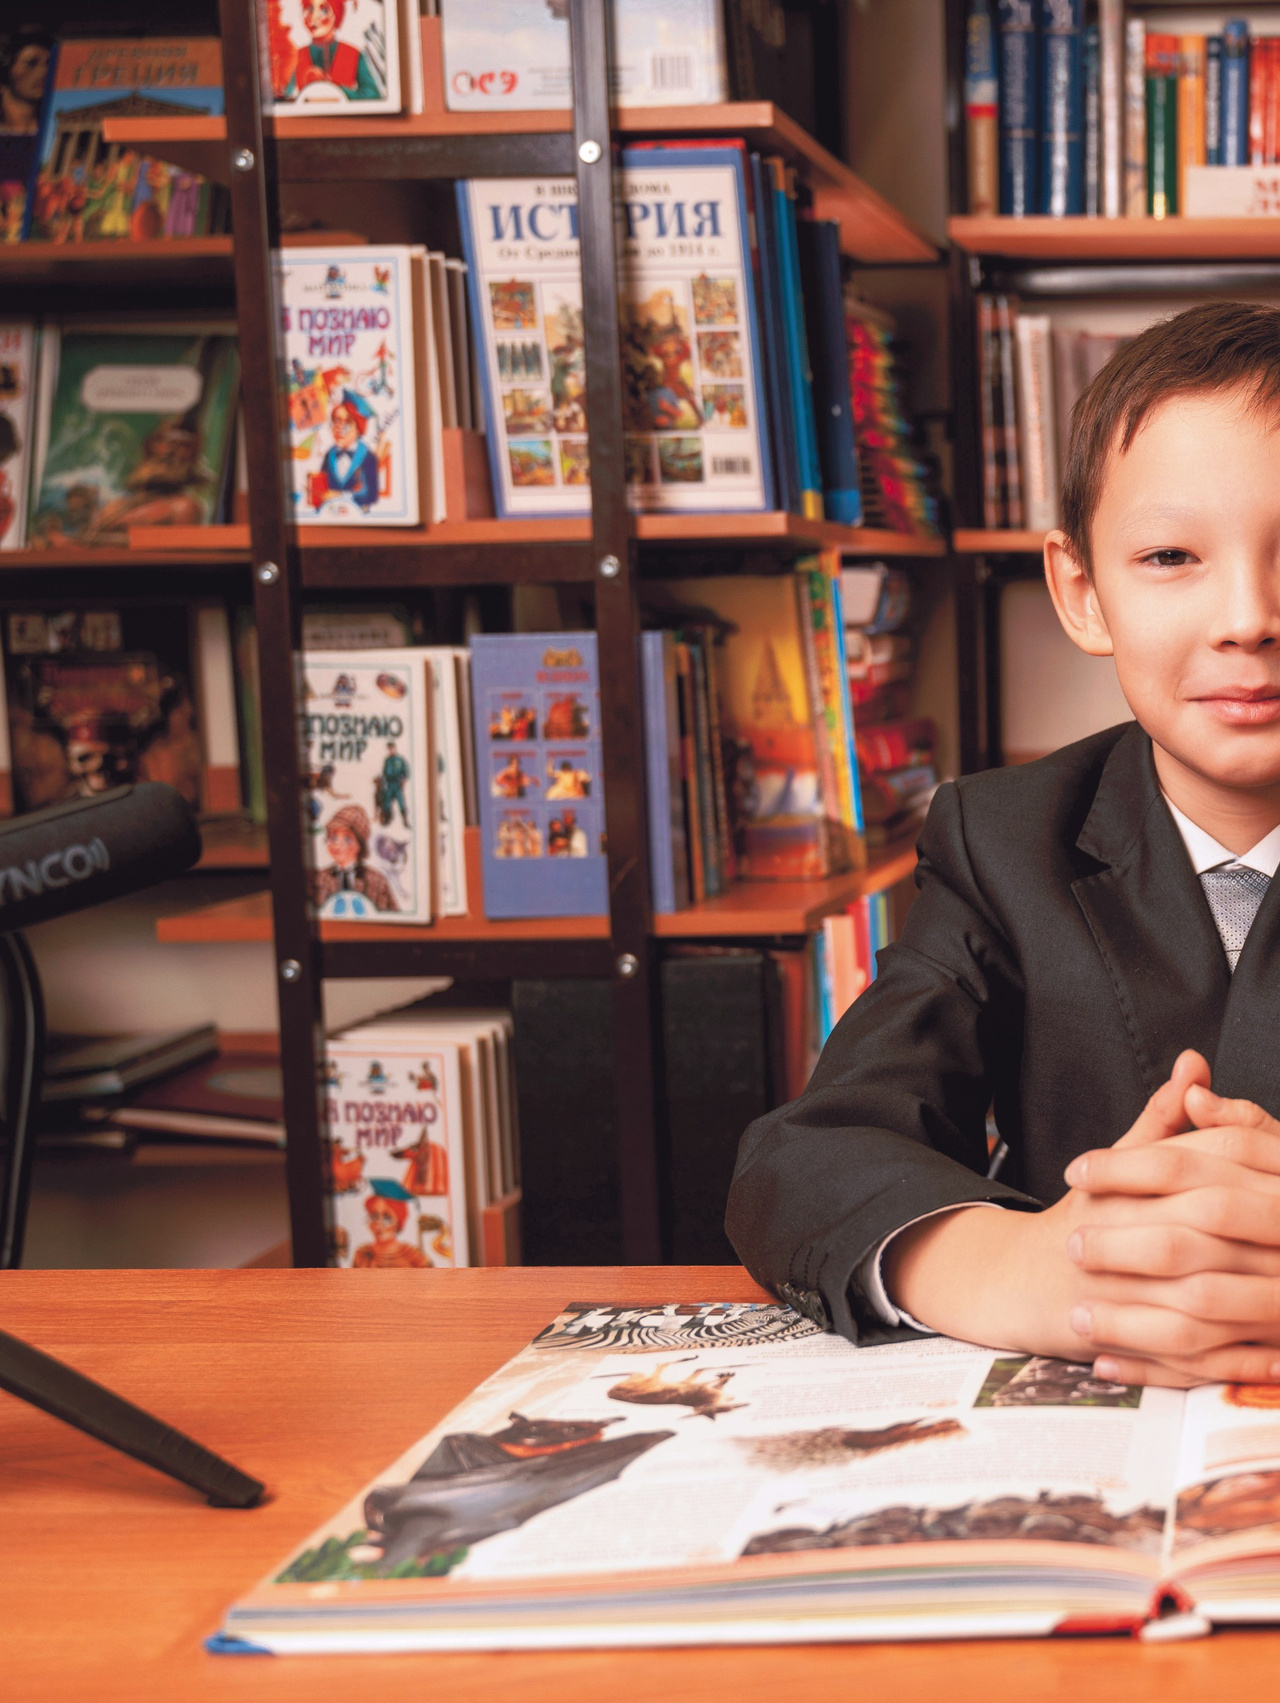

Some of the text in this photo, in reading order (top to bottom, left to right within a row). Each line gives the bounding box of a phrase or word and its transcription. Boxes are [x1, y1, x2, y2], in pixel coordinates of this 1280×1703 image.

[489, 200, 722, 242] ИСТРИЯ
[298, 306, 391, 332] ПОЗНАЮ
[308, 334, 357, 357] МИР
[304, 713, 404, 739] ПОЗНАЮ
[318, 738, 368, 762] МИР
[344, 1101, 439, 1125] ПОЗНАЮ
[356, 1125, 404, 1150] МИР
